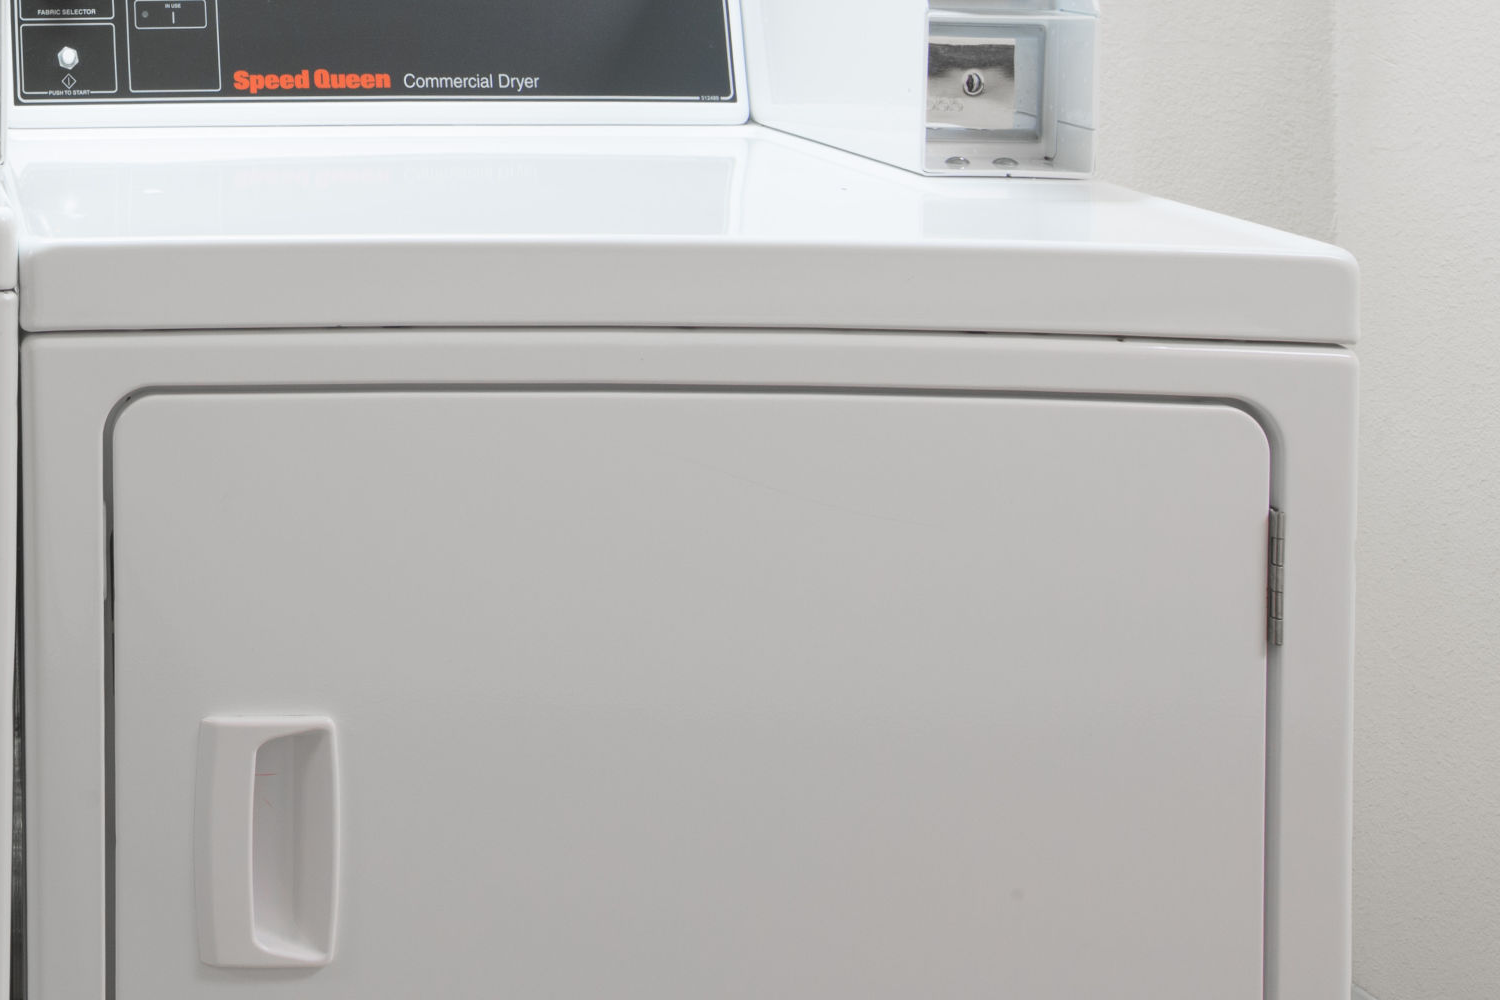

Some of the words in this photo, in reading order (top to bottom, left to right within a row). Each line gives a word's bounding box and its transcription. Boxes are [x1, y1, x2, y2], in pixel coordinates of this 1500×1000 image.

[233, 69, 310, 94] Speed
[313, 69, 391, 89] Queen
[403, 73, 493, 89] Commercial
[498, 73, 539, 92] Dryer
